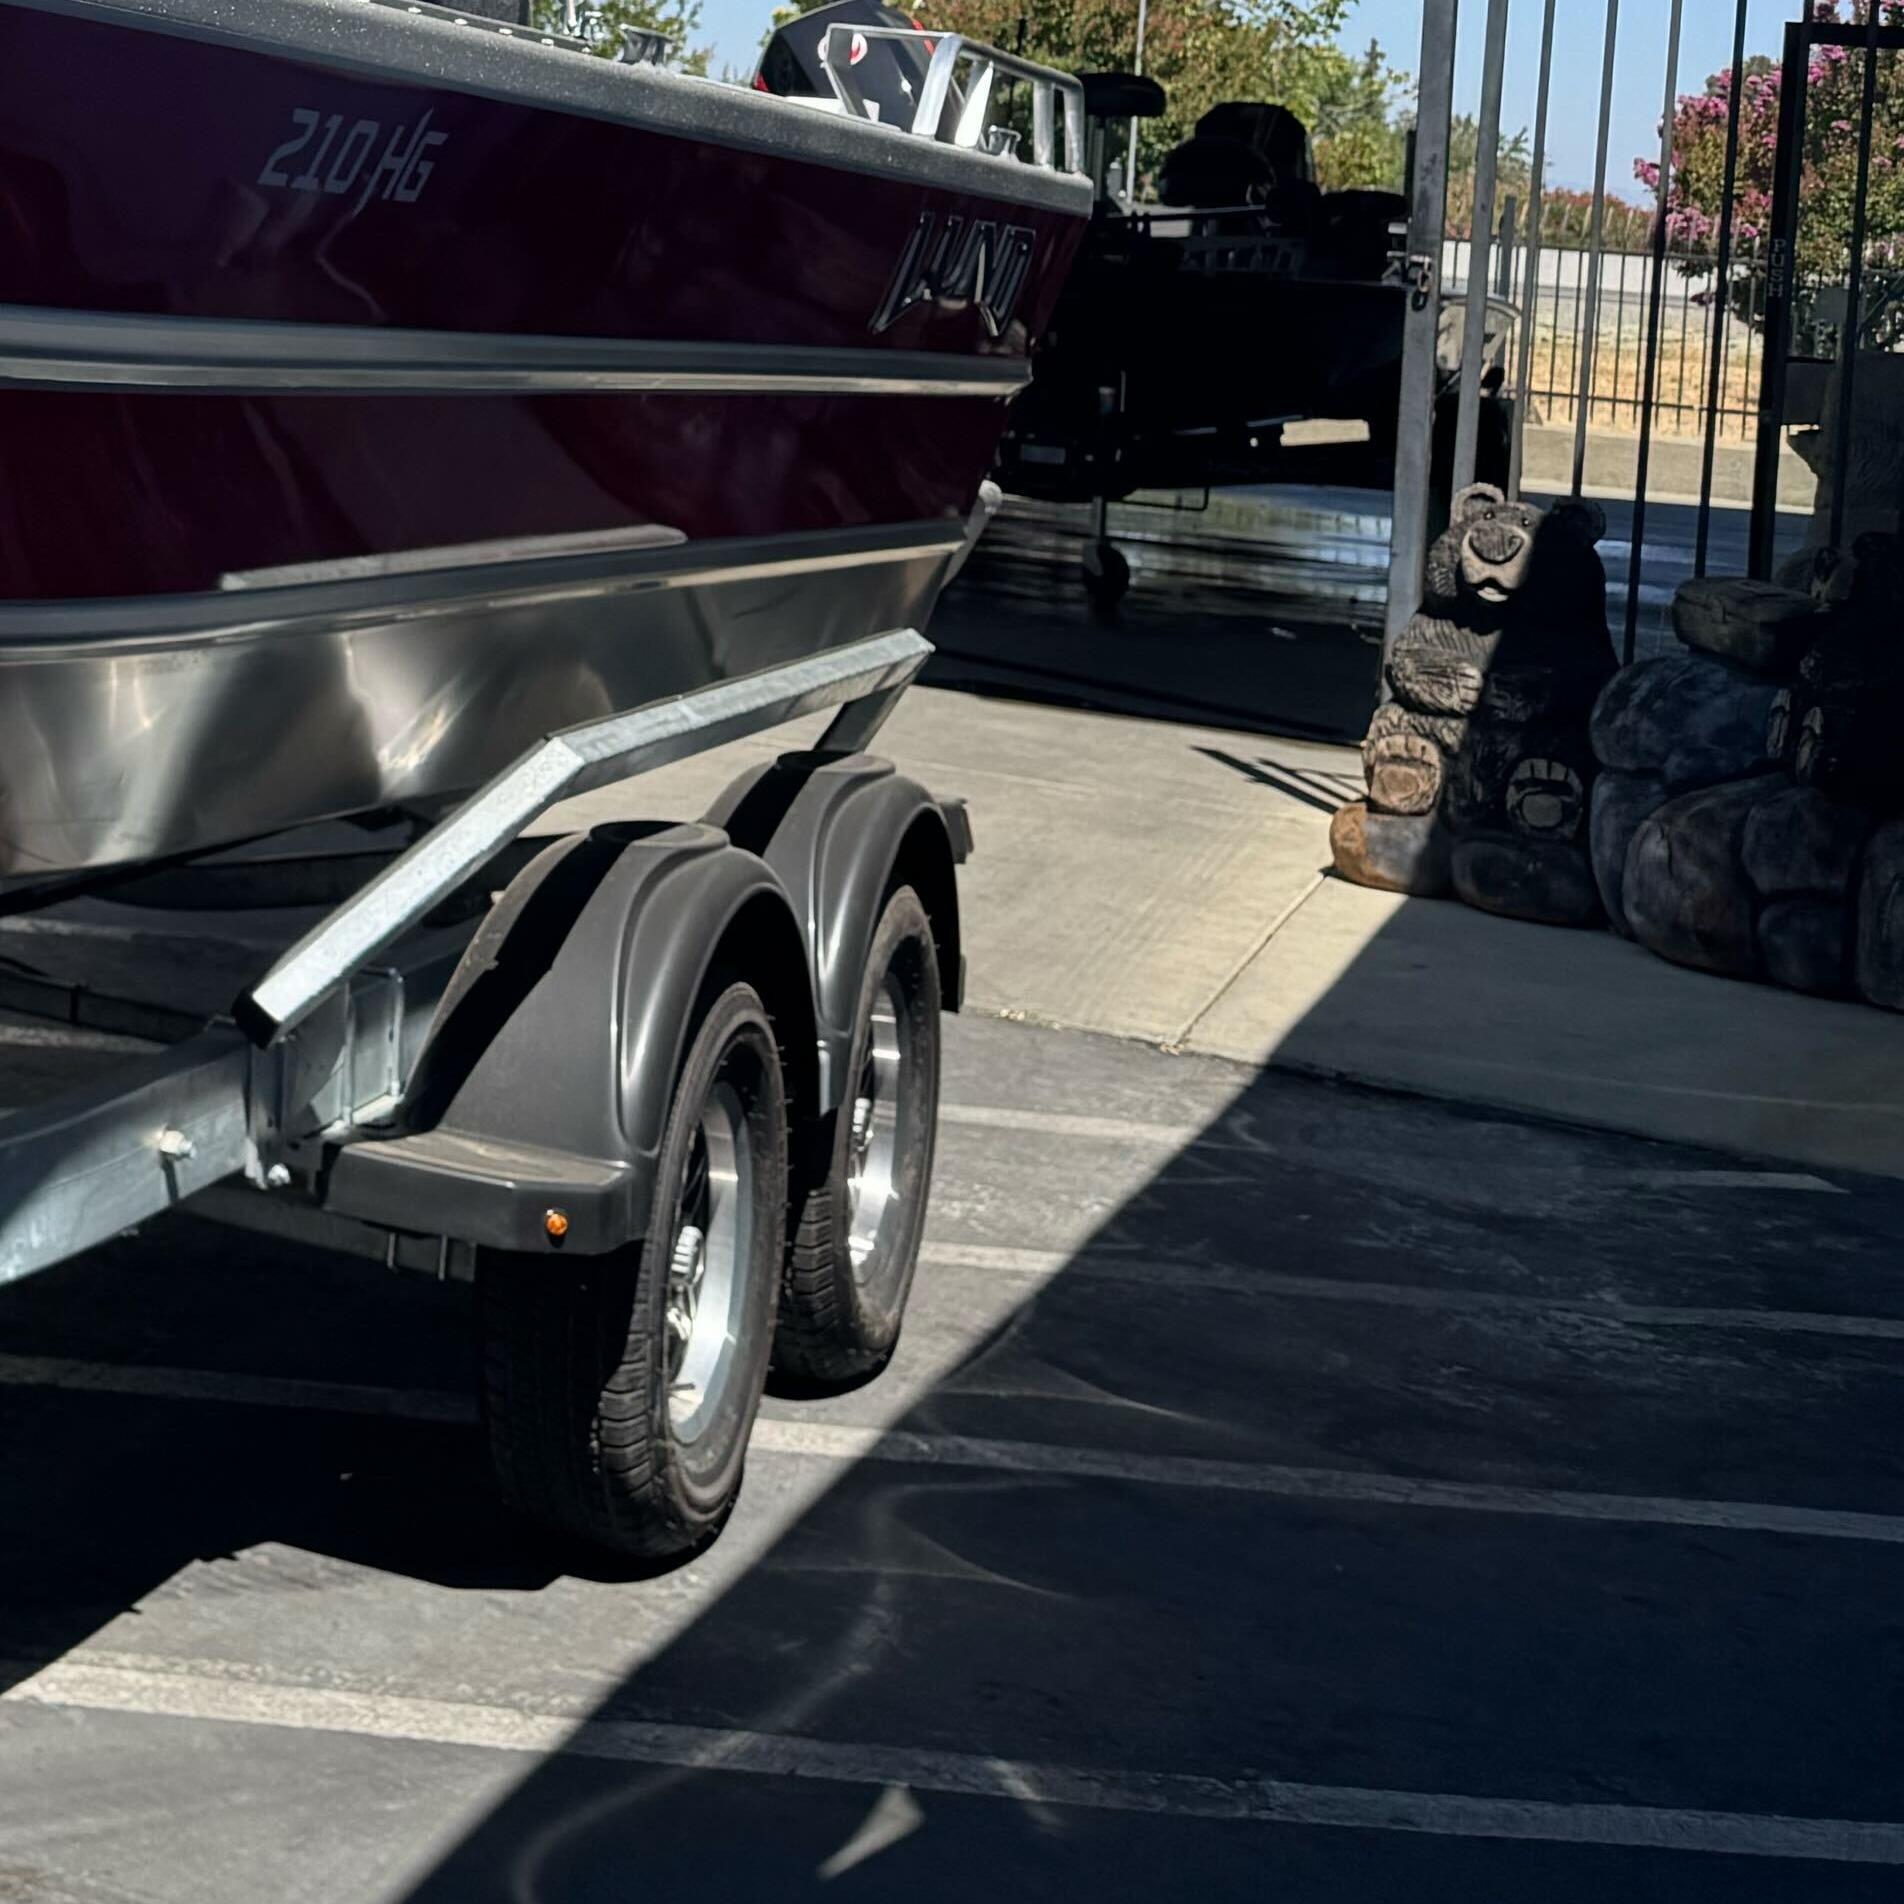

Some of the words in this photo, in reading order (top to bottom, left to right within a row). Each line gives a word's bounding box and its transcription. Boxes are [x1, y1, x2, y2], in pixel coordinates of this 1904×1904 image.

[257, 107, 380, 195] 210
[868, 211, 1036, 337] LUND
[1769, 238, 1787, 298] PUSH
